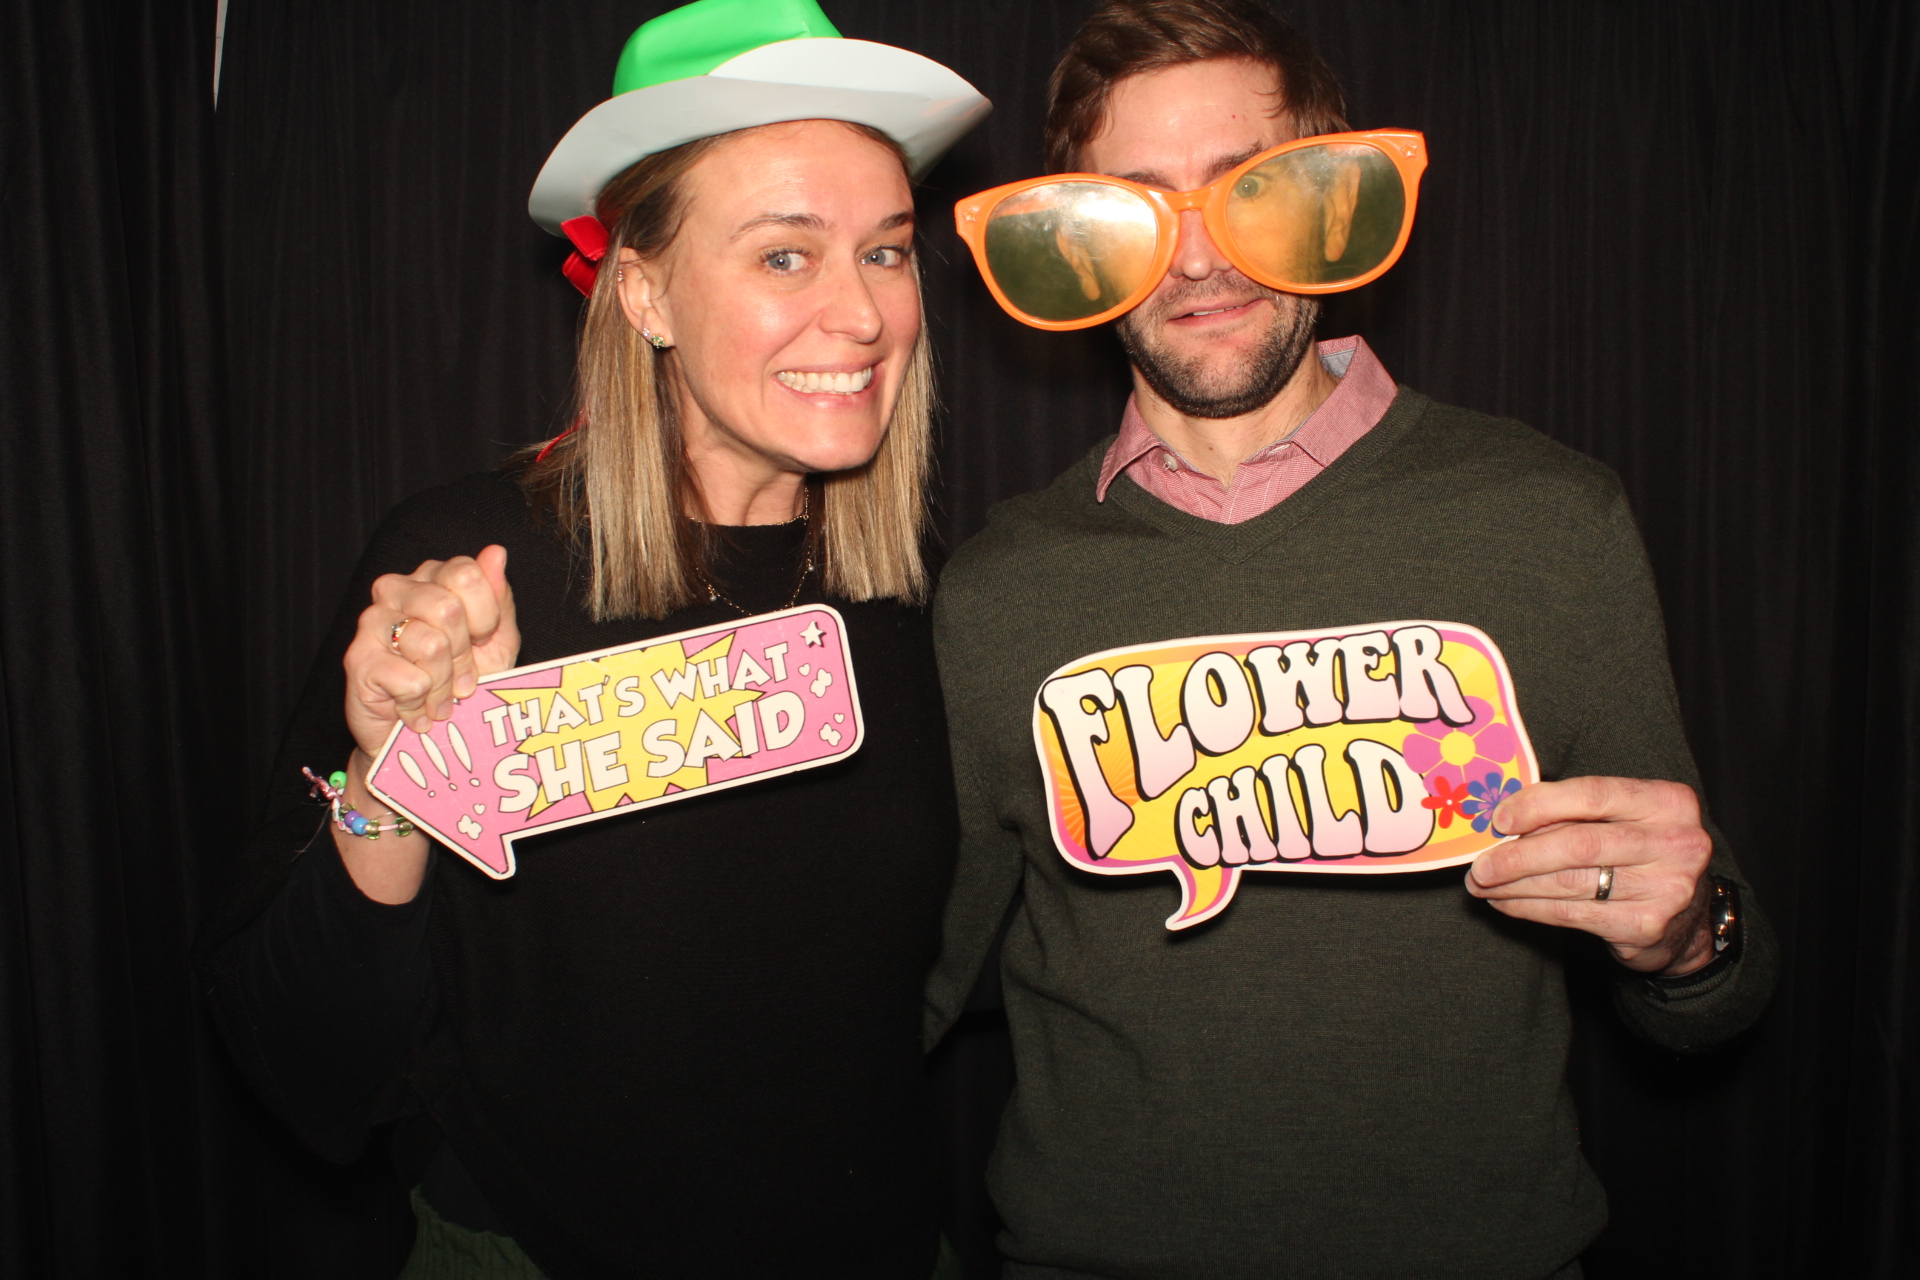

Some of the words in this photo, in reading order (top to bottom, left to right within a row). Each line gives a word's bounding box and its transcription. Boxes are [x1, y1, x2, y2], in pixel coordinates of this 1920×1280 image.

[482, 675, 646, 747] THAT'S
[651, 642, 788, 709] WHAT
[493, 731, 628, 813] SHE
[642, 691, 806, 779] SAID
[1041, 624, 1476, 860] FLOWER
[1174, 738, 1436, 870] CHILD
